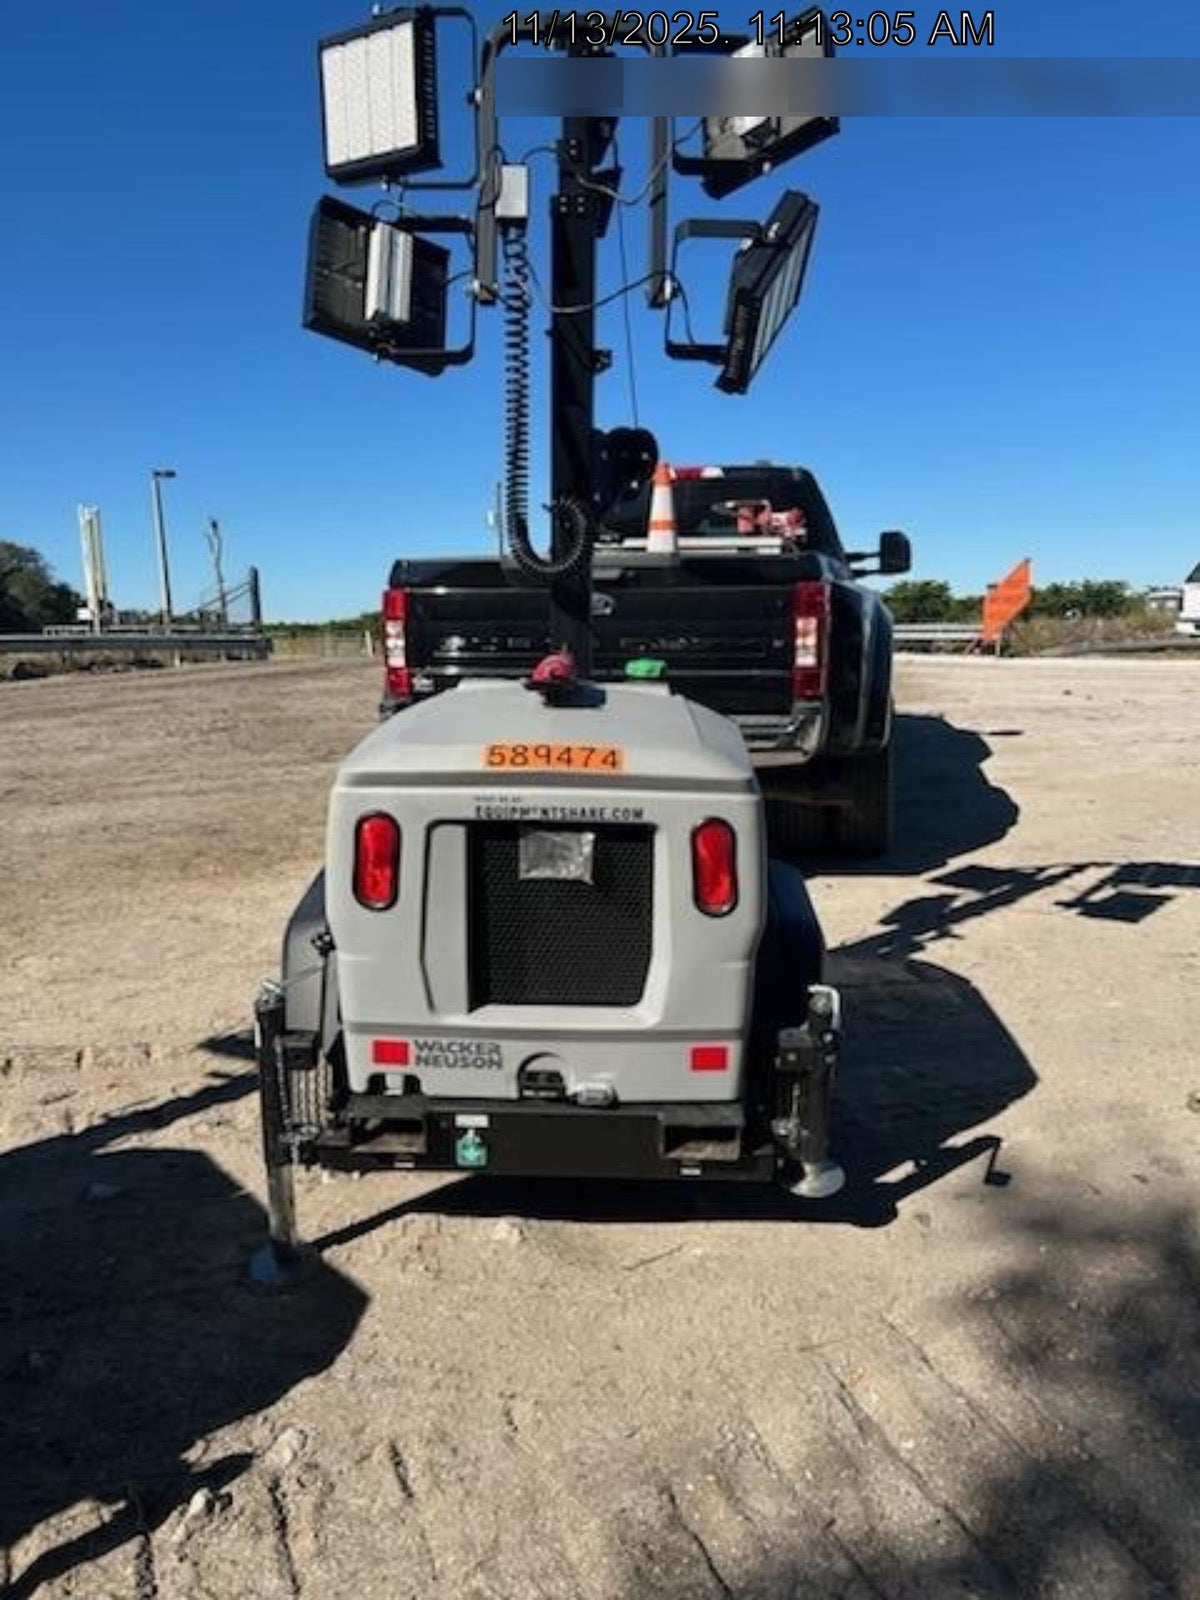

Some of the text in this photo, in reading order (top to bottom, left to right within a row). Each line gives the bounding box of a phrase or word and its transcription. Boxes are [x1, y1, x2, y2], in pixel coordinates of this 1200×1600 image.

[486, 744, 619, 769] 589474
[414, 1040, 501, 1055] WACKER
[414, 1054, 503, 1069] NEUSON
